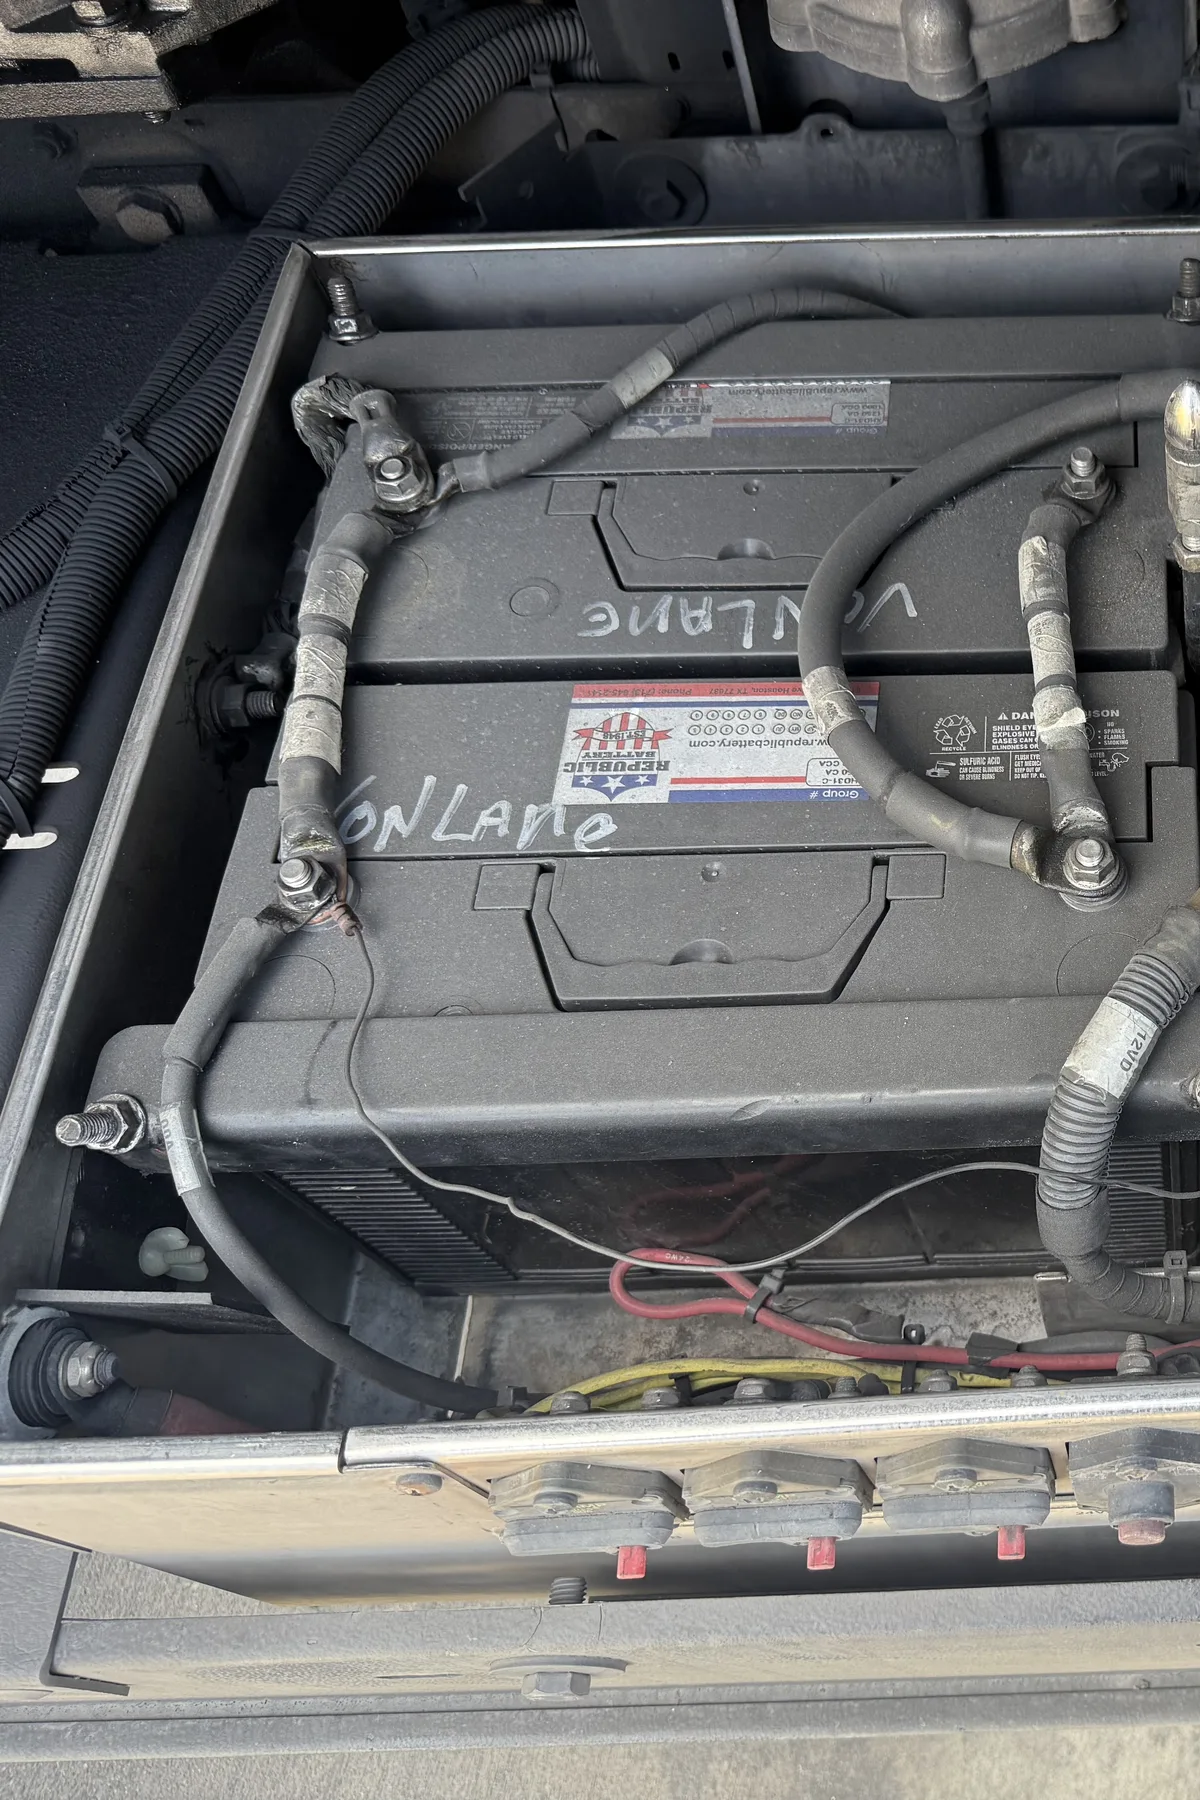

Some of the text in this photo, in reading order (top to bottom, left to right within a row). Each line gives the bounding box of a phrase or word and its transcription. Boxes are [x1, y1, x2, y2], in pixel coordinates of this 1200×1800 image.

[845, 426, 878, 436] Group
[658, 688, 692, 696] Phone:
[689, 737, 830, 749] w.republicbattery.com
[581, 751, 657, 760] BATTERY
[959, 756, 1001, 766] SULFURIC ACID
[562, 759, 671, 774] REPUBLIC
[822, 777, 858, 786] HD31-C
[810, 788, 860, 800] Group #
